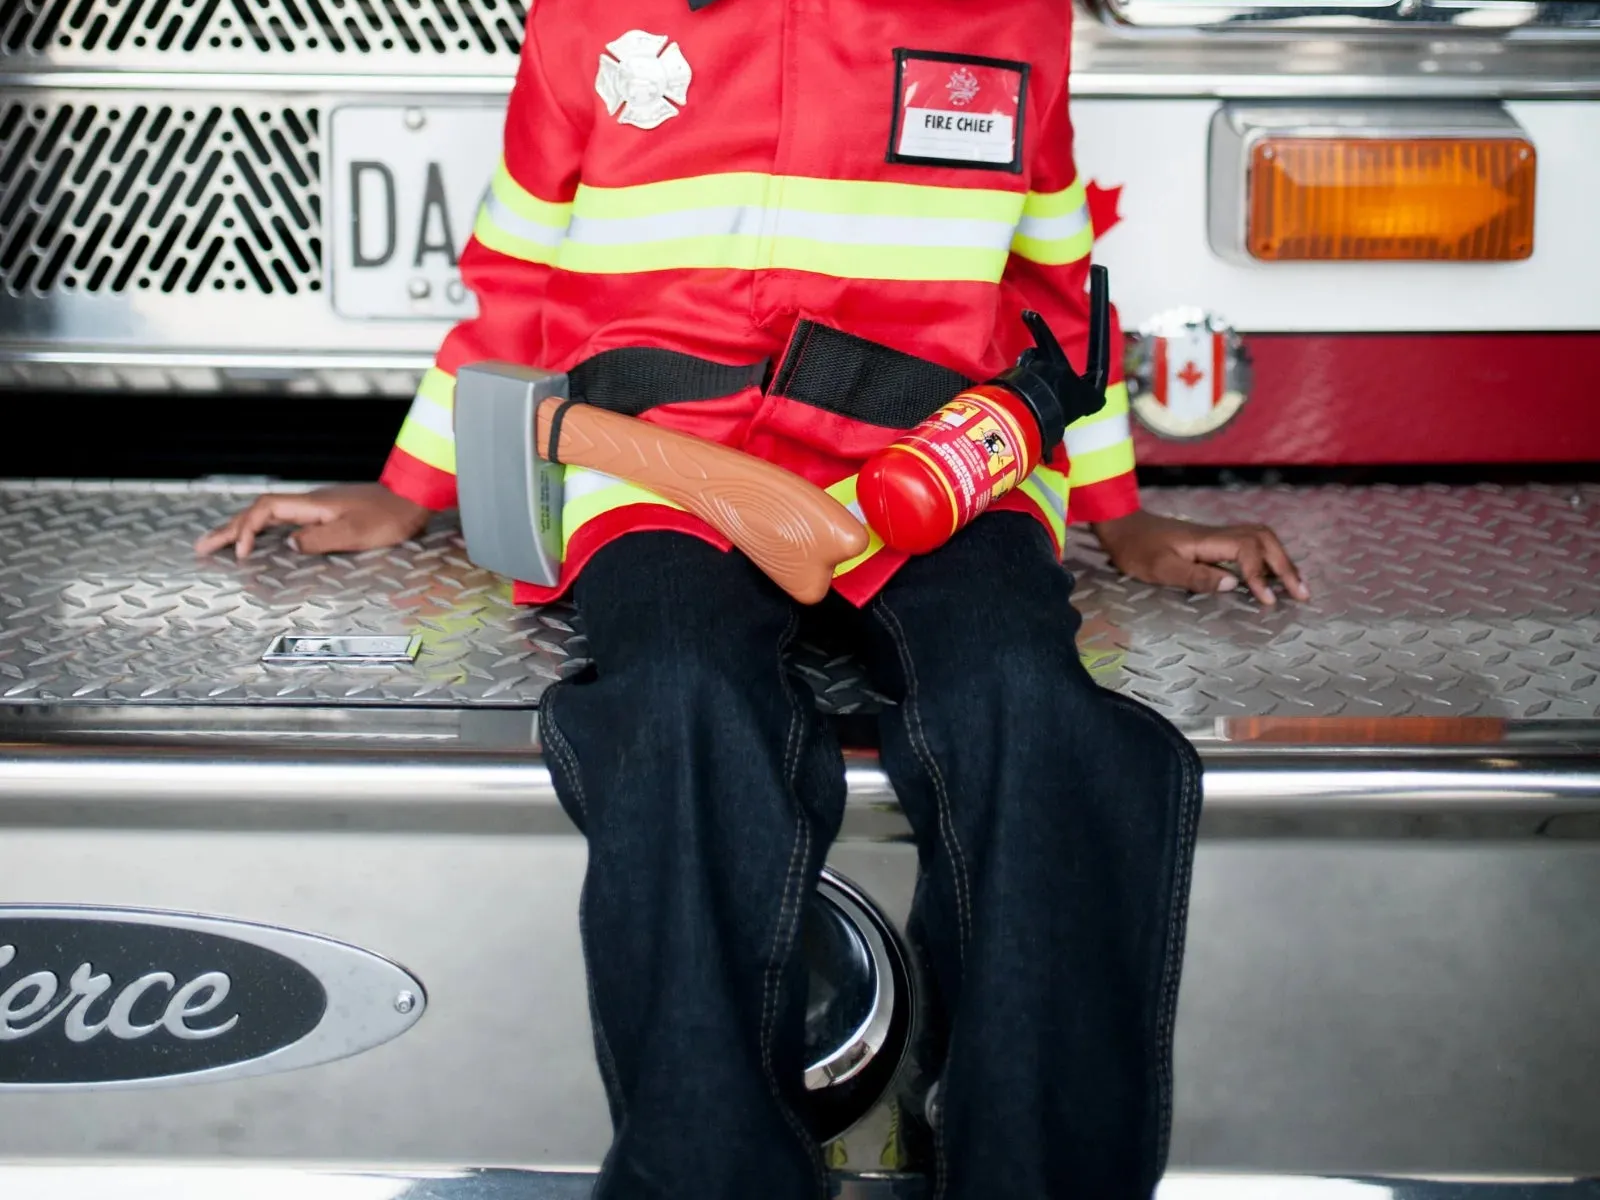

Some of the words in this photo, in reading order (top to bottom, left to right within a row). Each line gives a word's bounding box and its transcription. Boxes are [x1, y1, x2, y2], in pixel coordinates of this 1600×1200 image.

[924, 114, 952, 130] FIRE
[956, 117, 995, 133] CHIEF
[350, 161, 458, 268] DA
[942, 443, 976, 496] OPERATING
